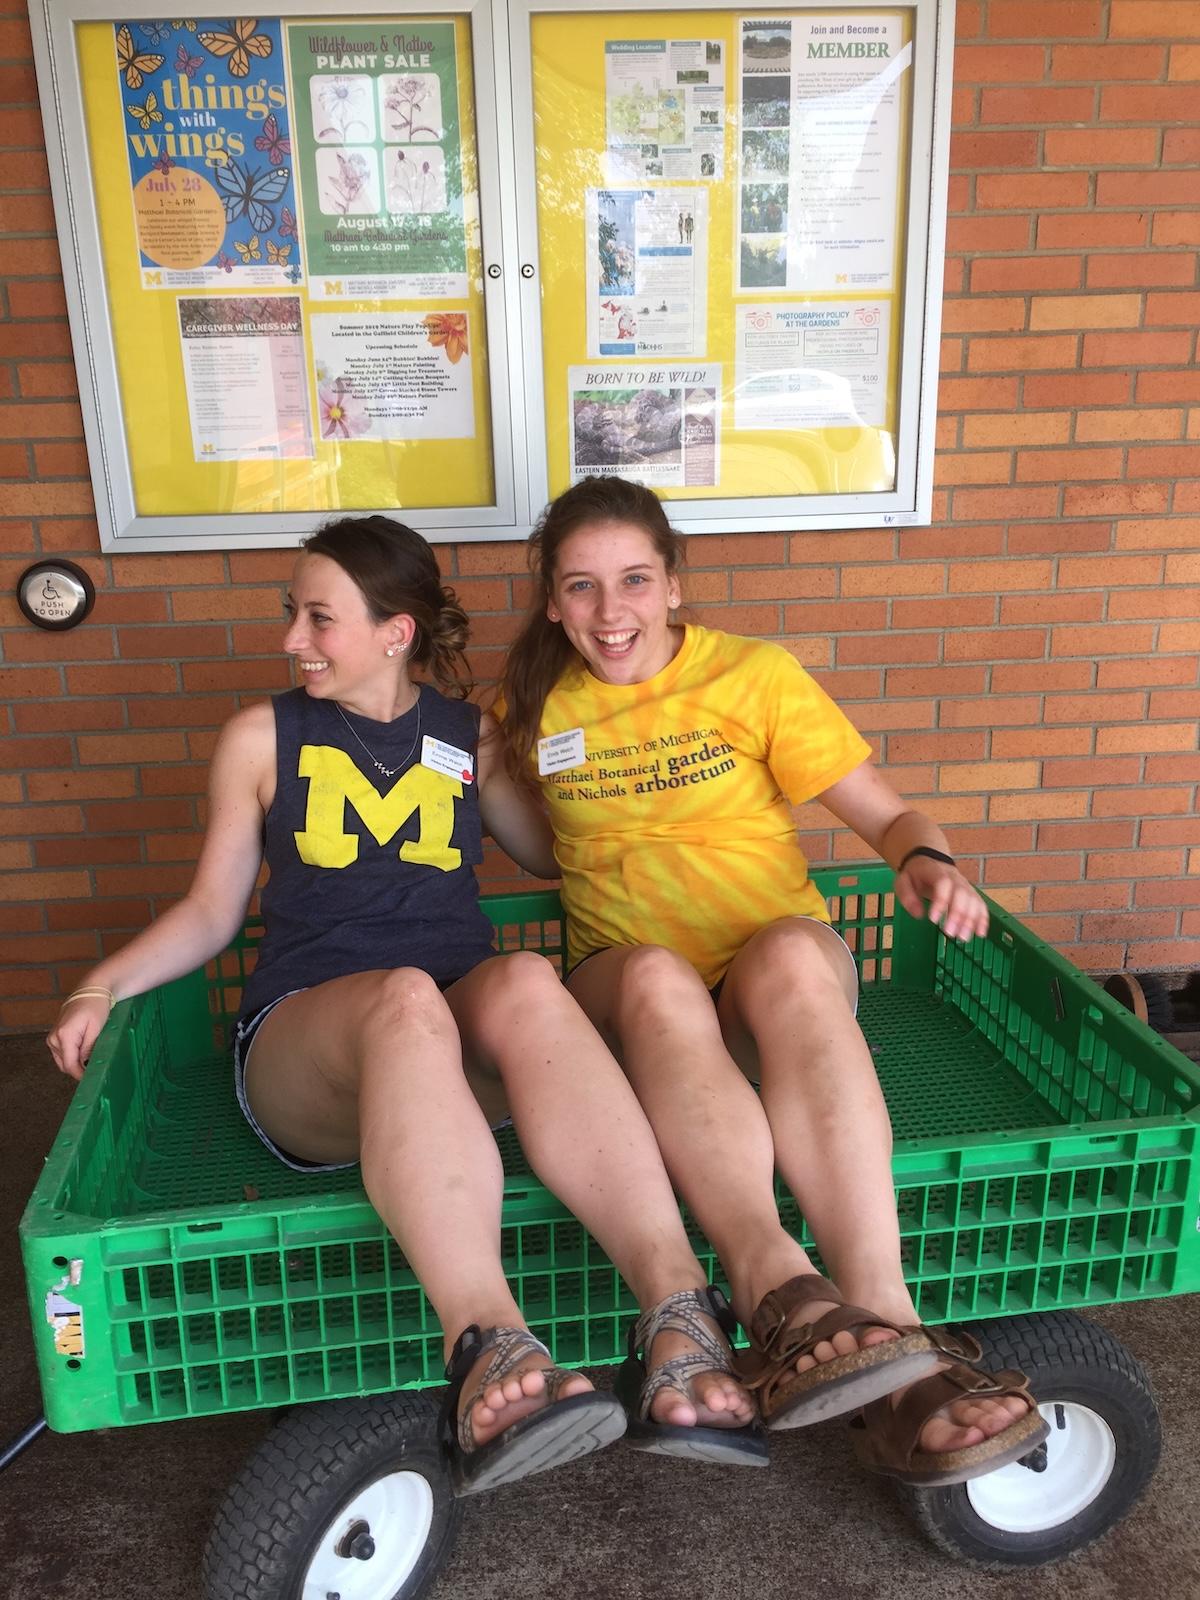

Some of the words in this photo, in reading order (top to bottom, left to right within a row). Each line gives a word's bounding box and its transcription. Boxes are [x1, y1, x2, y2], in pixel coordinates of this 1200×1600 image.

[810, 25, 827, 35] Join
[829, 25, 844, 35] and
[847, 24, 878, 35] Become
[881, 26, 887, 34] a
[309, 36, 376, 60] Wildflower
[380, 35, 389, 51] &
[393, 34, 436, 53] Native
[806, 41, 890, 59] MEMBER
[316, 54, 378, 69] PLANT
[384, 54, 431, 68] SALE
[161, 74, 286, 121] things
[179, 111, 217, 128] with
[128, 123, 245, 168] wings
[146, 177, 177, 196] July
[182, 177, 201, 192] 28
[336, 216, 387, 231] August
[331, 244, 341, 252] 10
[372, 243, 393, 251] 4:30
[394, 244, 410, 254] pm
[776, 312, 825, 320] PHOTOGRAPHY
[826, 311, 849, 319] POLICY
[785, 320, 794, 328] AT
[808, 319, 840, 327] GARDENS
[186, 324, 235, 333] CAREGIVER
[235, 322, 280, 332] WELLNESS
[280, 322, 298, 331] DAY
[585, 372, 626, 385] BORN
[627, 372, 645, 384] TO
[648, 371, 665, 384] BE
[668, 371, 706, 383] WILD!
[575, 466, 600, 474] EASTERN
[48, 609, 71, 617] OPEN
[584, 745, 641, 766] NIVERSITY
[643, 741, 657, 753] OF
[598, 759, 660, 780] Botanical
[558, 788, 574, 801] and
[578, 785, 627, 801] Nichols
[634, 758, 736, 794] arboretum
[293, 744, 464, 872] M
